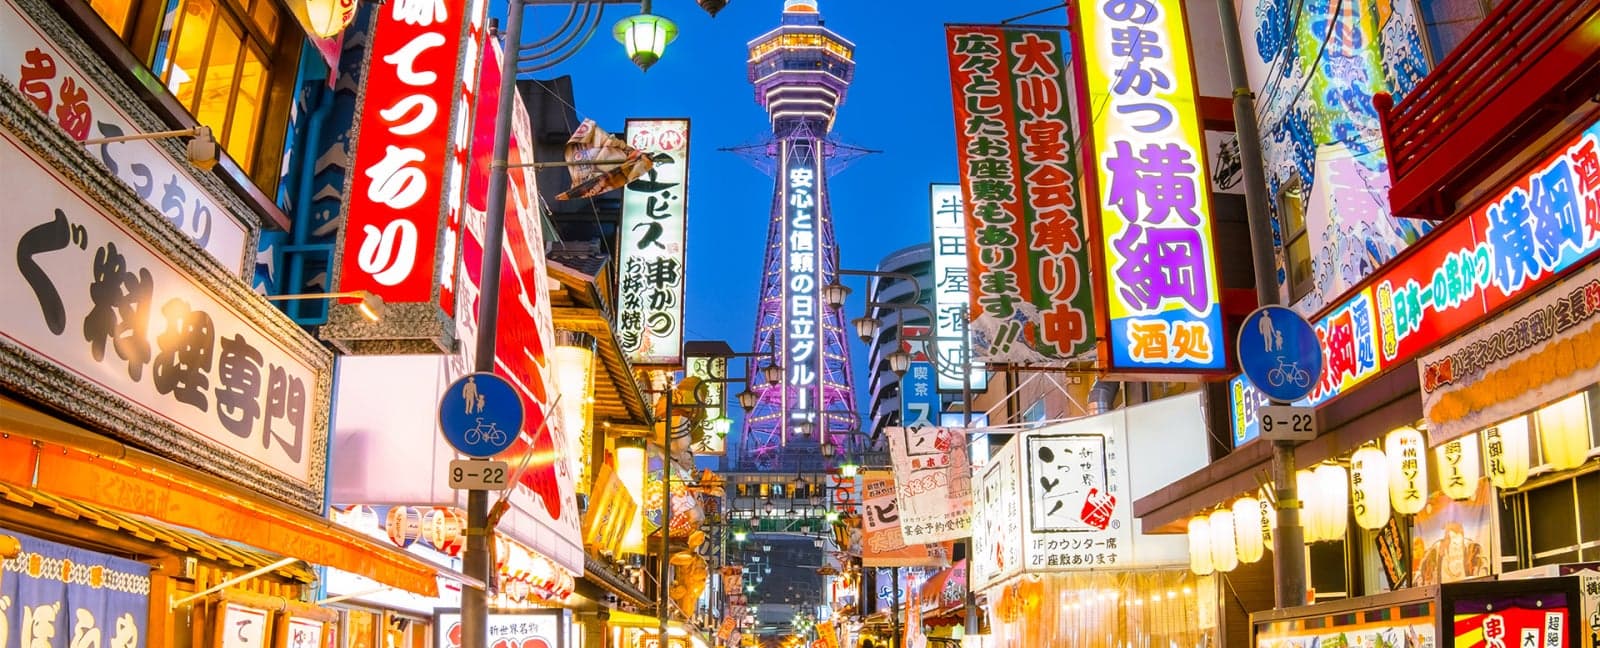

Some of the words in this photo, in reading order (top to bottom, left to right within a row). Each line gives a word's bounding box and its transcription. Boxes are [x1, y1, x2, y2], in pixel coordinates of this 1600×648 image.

[1107, 141, 1209, 313] 横綱
[1488, 160, 1584, 292] 横綱
[621, 256, 646, 350] お好み焼き
[646, 257, 680, 335] 串かつ
[789, 168, 816, 434] 安心と信頼の日立グループ
[1394, 246, 1490, 336] 日本一の串かつ
[17, 208, 307, 464] ぐ料理専門
[1132, 323, 1209, 360] 酒処
[1353, 299, 1374, 373] 酒処
[913, 366, 929, 397] 喫茶
[1263, 415, 1313, 432] 9-22
[453, 468, 504, 484] 9-22
[1032, 555, 1044, 566] 2F
[1048, 553, 1118, 566] 座敷あります
[1033, 540, 1044, 550] 1F
[1048, 538, 1117, 550] カウンター席
